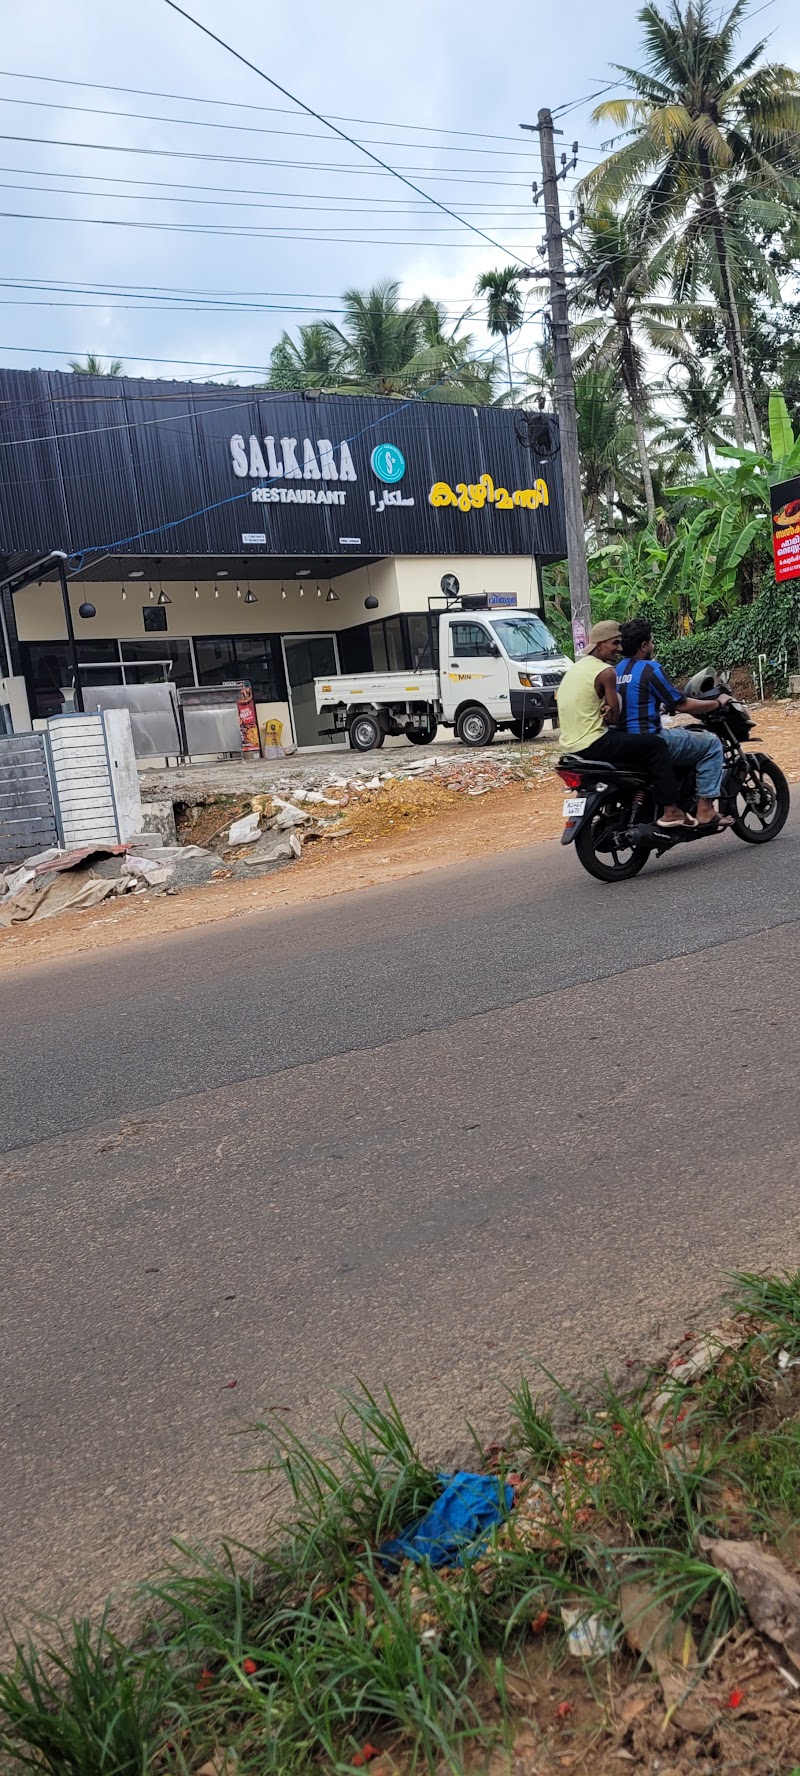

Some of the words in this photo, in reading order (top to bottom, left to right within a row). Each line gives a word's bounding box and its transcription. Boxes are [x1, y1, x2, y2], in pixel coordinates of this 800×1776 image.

[230, 434, 357, 481] SALKARA
[251, 487, 346, 505] RESTAURANT
[429, 473, 549, 512] കുഴിമന്തി
